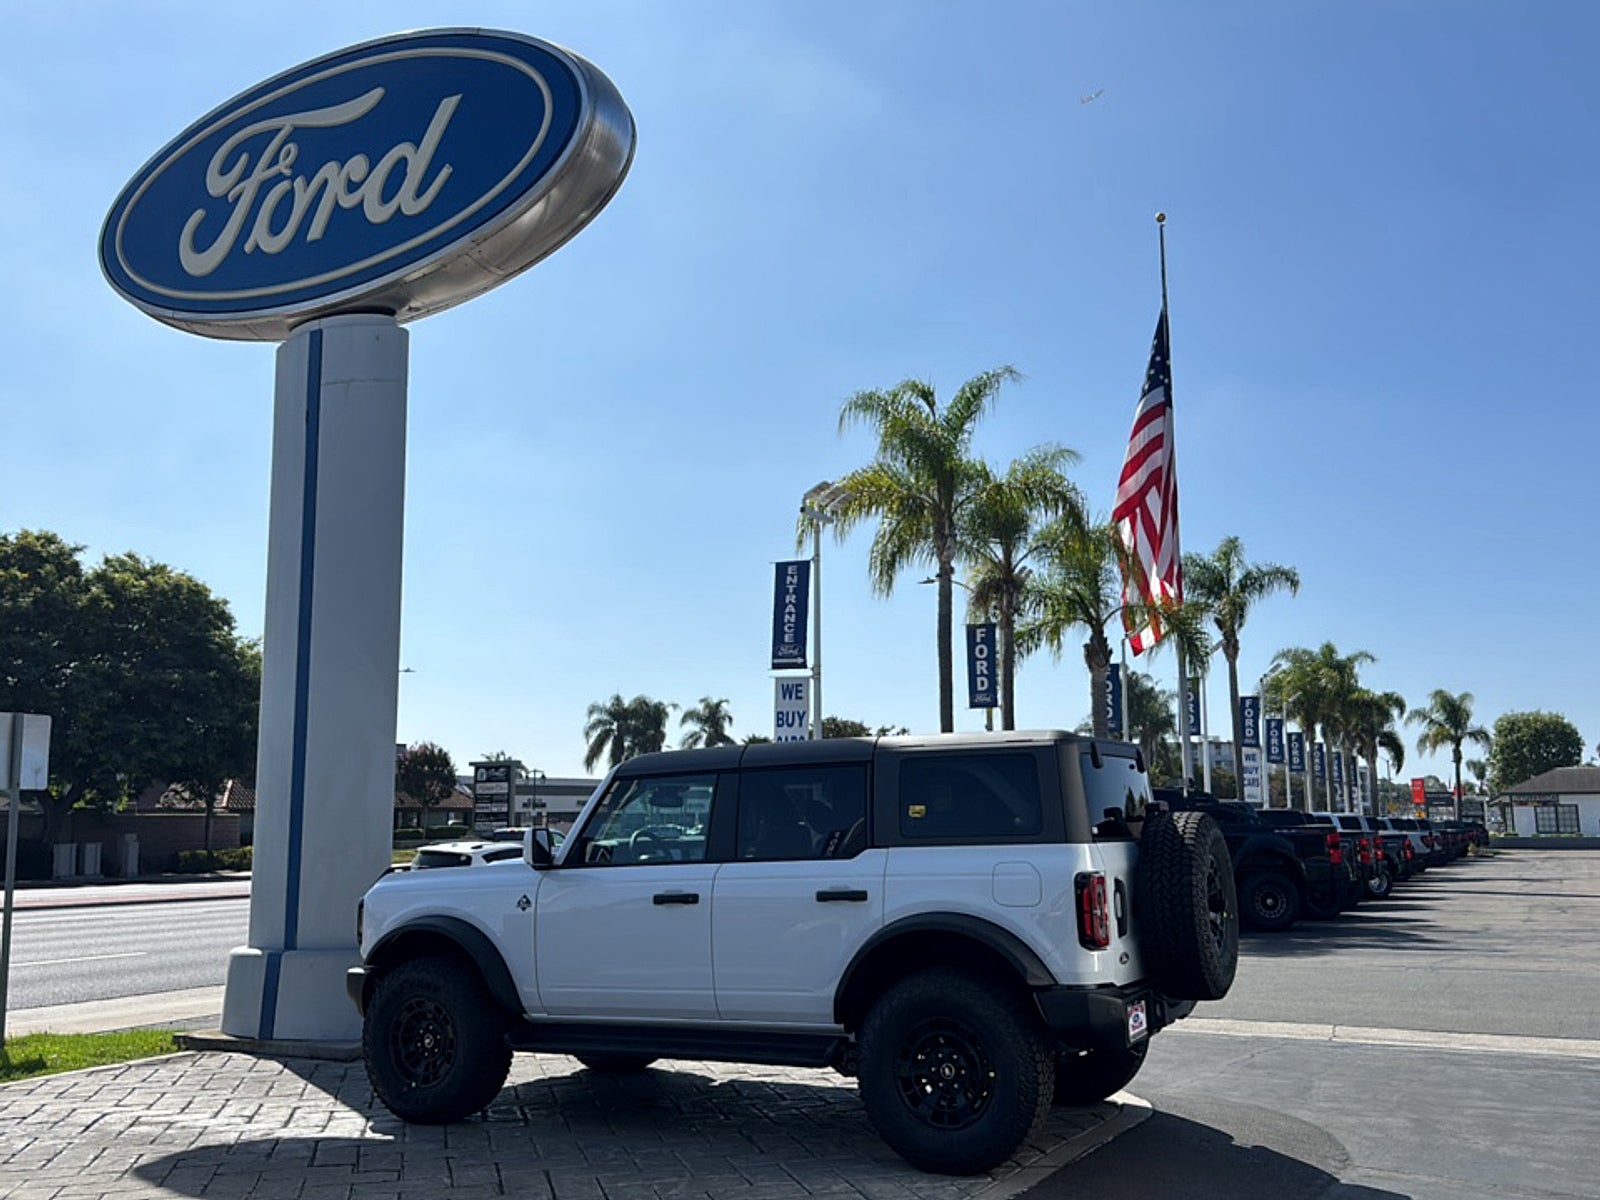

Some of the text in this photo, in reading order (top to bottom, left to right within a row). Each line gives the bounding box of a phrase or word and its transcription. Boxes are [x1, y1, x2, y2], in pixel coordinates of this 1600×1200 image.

[178, 86, 463, 277] Ford
[783, 564, 798, 643] ENTRANCE
[974, 627, 989, 692] FORD
[781, 683, 803, 700] WE
[776, 711, 806, 728] BUY
[1244, 699, 1255, 737] FORD
[1269, 721, 1280, 755] FORD
